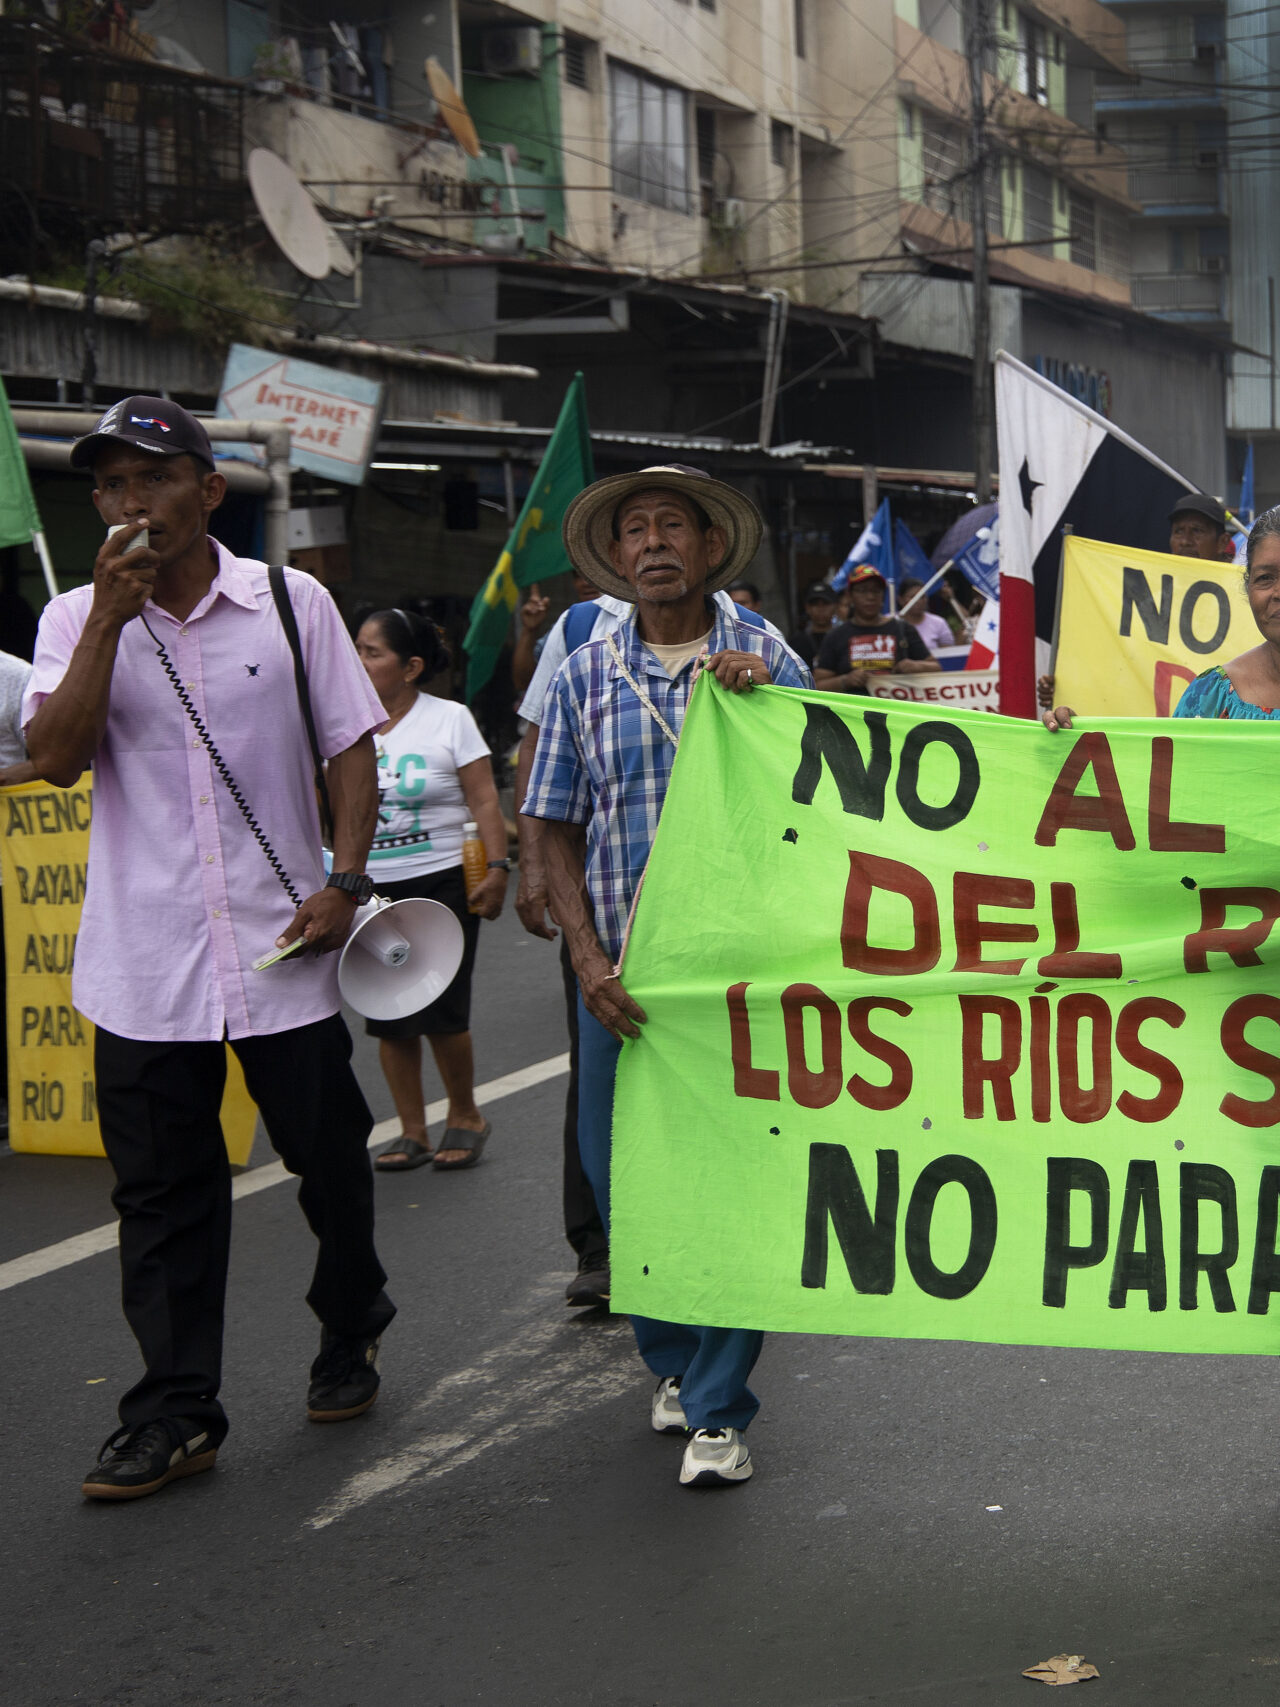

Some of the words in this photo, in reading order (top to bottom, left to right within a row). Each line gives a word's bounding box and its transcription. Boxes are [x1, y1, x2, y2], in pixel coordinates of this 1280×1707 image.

[255, 382, 360, 427] INTERNET
[1119, 566, 1231, 655] NO
[791, 702, 981, 832] NO
[1034, 731, 1226, 853] AL
[840, 849, 1122, 979] DEL
[726, 982, 914, 1112] LOS
[957, 981, 1186, 1124] RÍOS
[801, 1142, 998, 1300] NO
